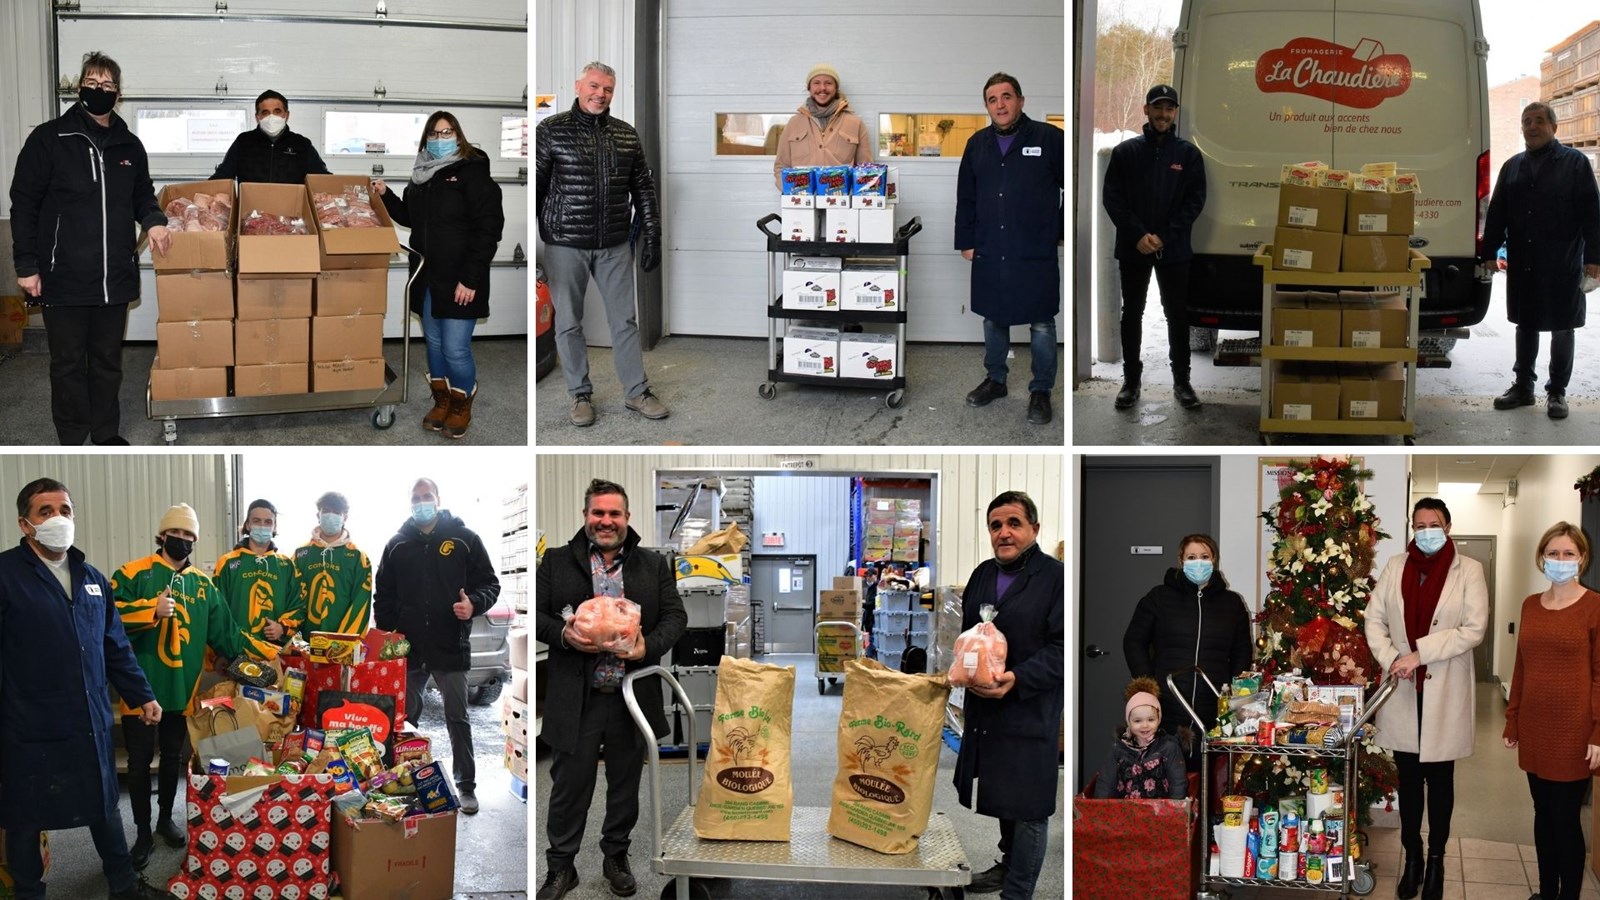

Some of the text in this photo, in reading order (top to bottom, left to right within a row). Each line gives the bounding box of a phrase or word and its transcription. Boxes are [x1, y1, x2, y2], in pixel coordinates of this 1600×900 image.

[1265, 60, 1292, 82] La
[1269, 111, 1370, 123] Un produit aux accents
[1324, 124, 1343, 133] bien
[1345, 124, 1357, 133] de
[1359, 125, 1378, 134] chez
[157, 588, 195, 604] CNDORS
[722, 777, 772, 792] BIOLOGIQUE
[859, 778, 891, 793] MOULÉE
